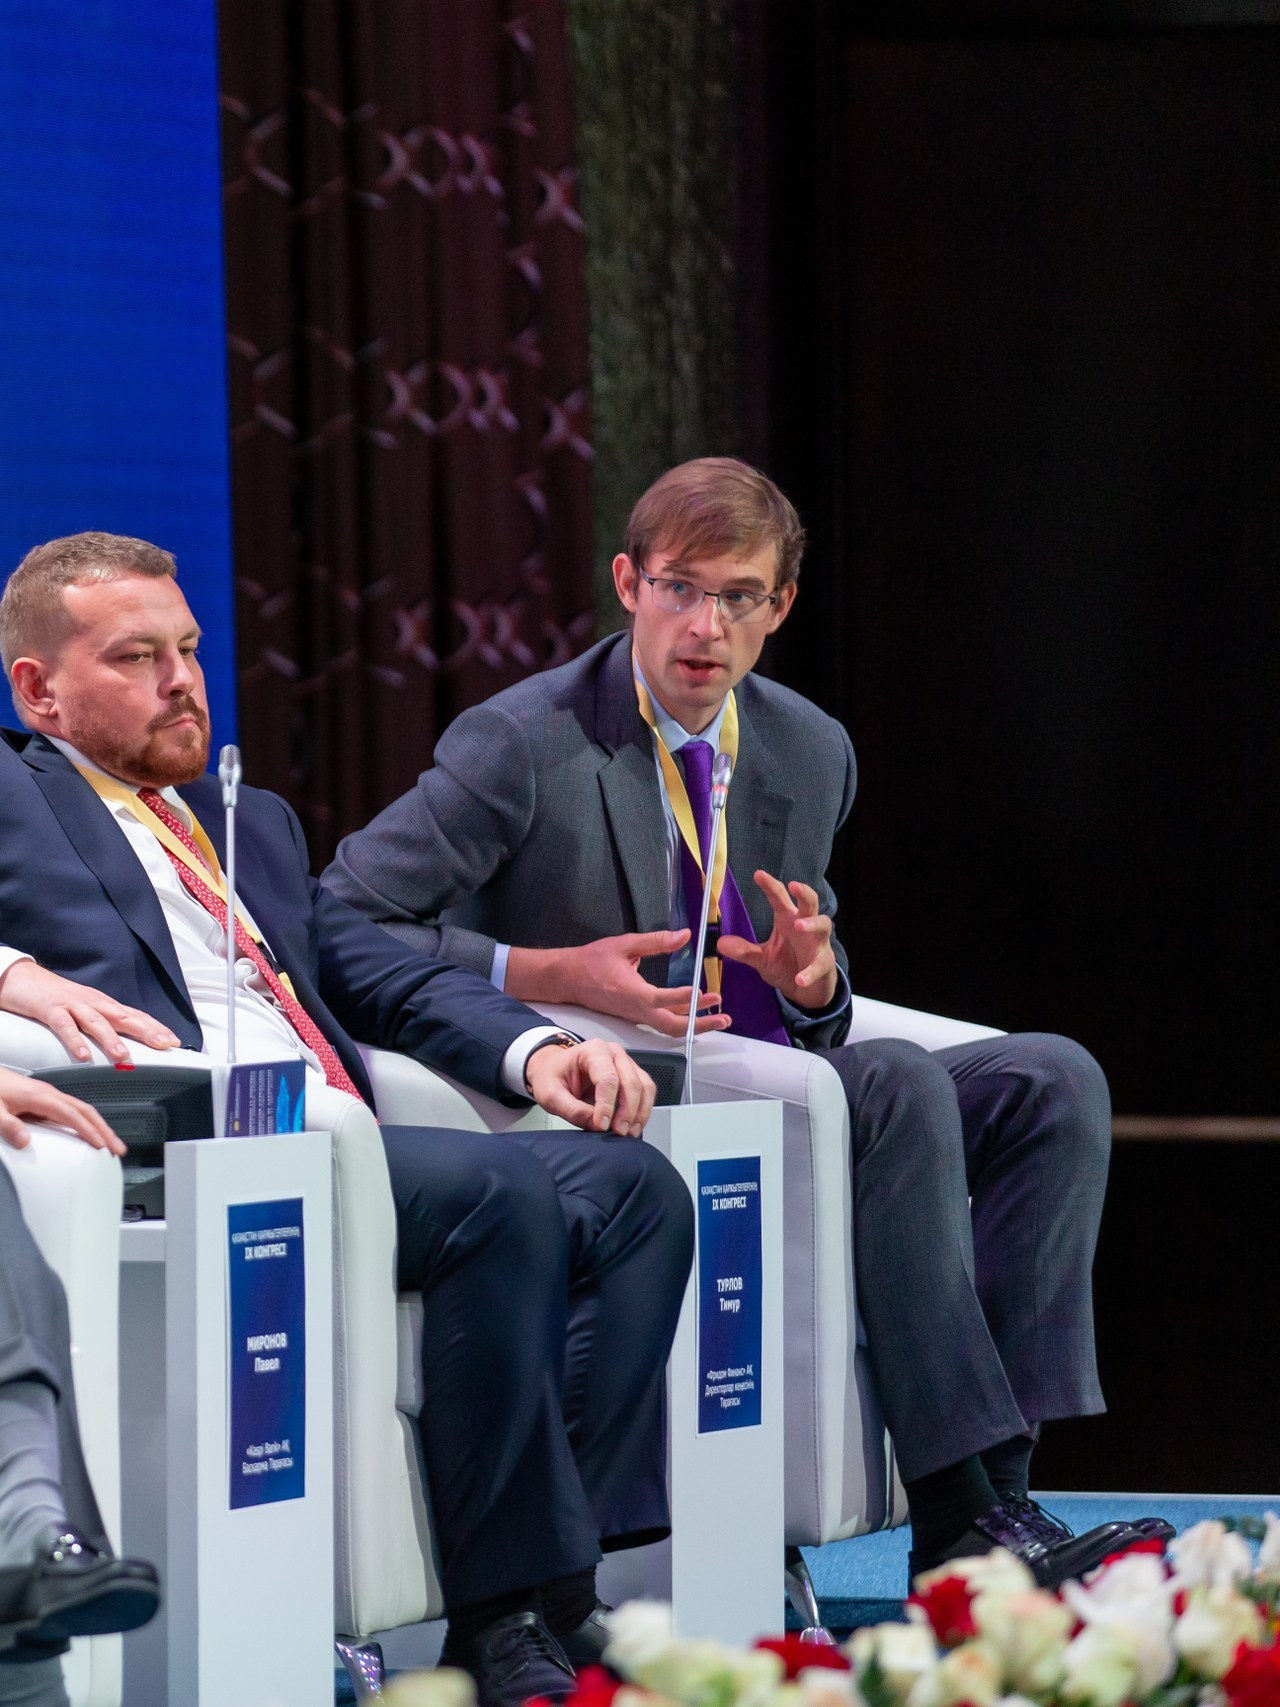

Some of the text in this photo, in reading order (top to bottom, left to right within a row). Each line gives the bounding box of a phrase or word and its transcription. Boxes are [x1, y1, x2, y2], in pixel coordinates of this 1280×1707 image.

[716, 1276, 743, 1292] ТУРЛОВ
[720, 1298, 740, 1313] Тимур
[247, 1332, 288, 1352] МИРОНОВ
[254, 1356, 280, 1373] Павел
